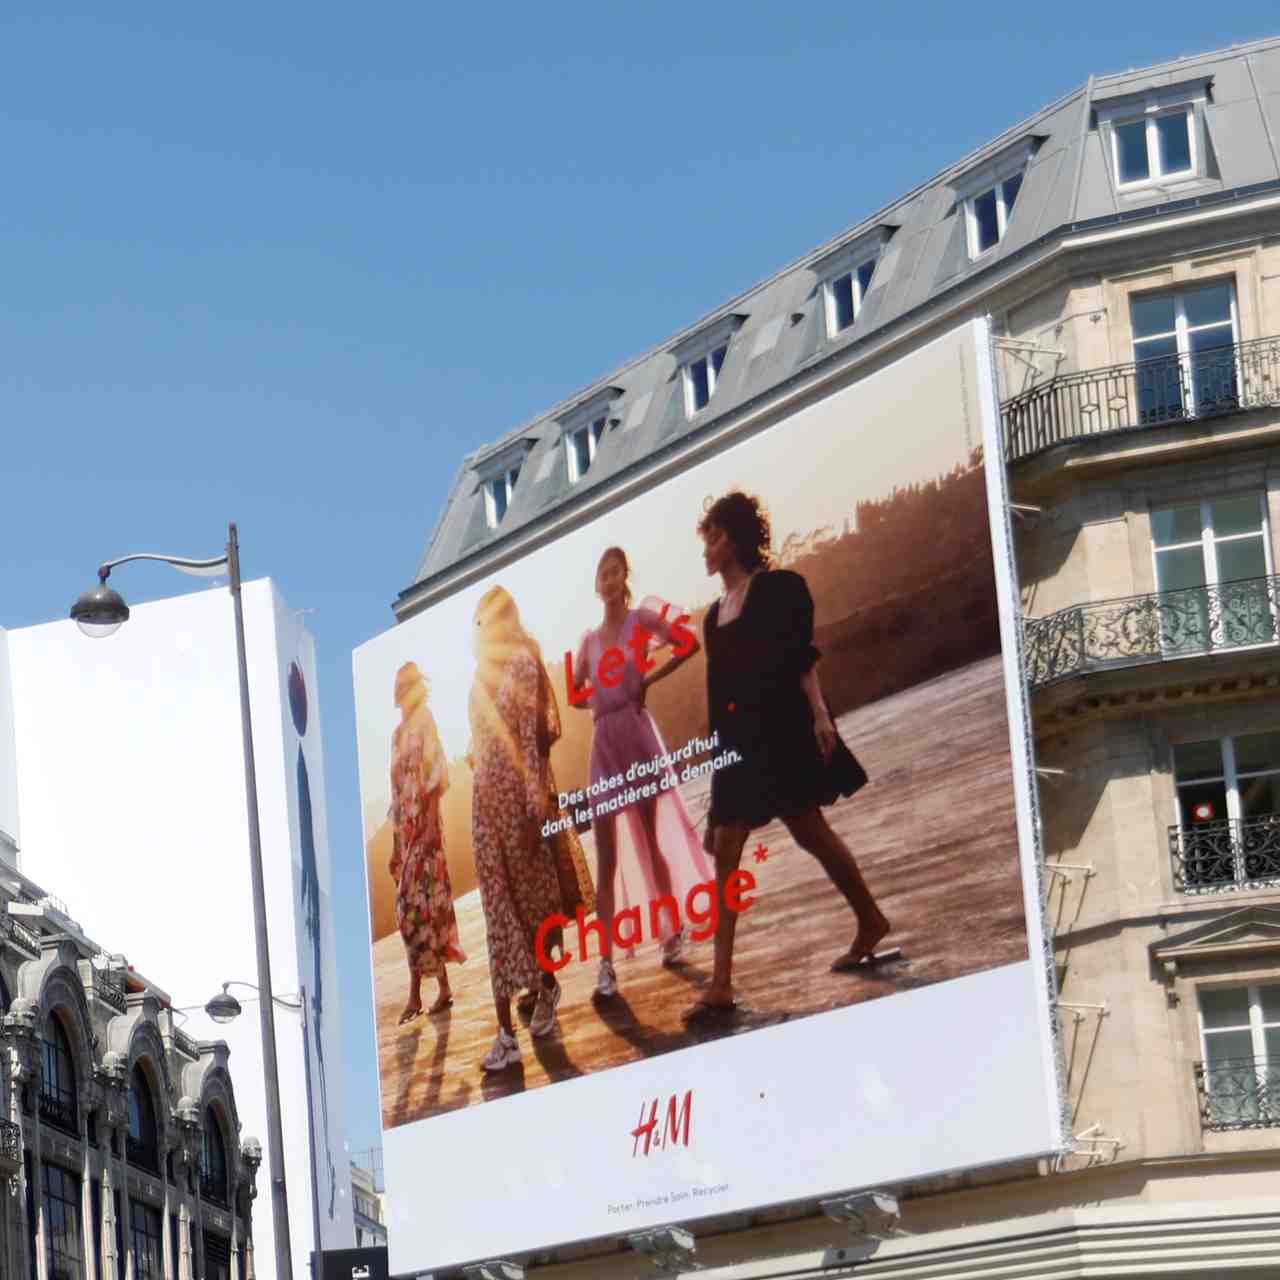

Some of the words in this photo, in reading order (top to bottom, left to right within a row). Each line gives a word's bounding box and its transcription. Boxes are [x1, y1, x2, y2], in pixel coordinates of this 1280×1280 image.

[564, 602, 697, 706] Let's
[541, 817, 573, 838] dans
[575, 809, 593, 825] les
[596, 781, 658, 816] matières
[659, 773, 678, 791] de
[681, 750, 743, 783] demain.
[558, 789, 584, 810] Des
[586, 773, 624, 800] robes
[625, 731, 720, 783] d'aujourd'hui
[631, 1091, 695, 1158] H&M
